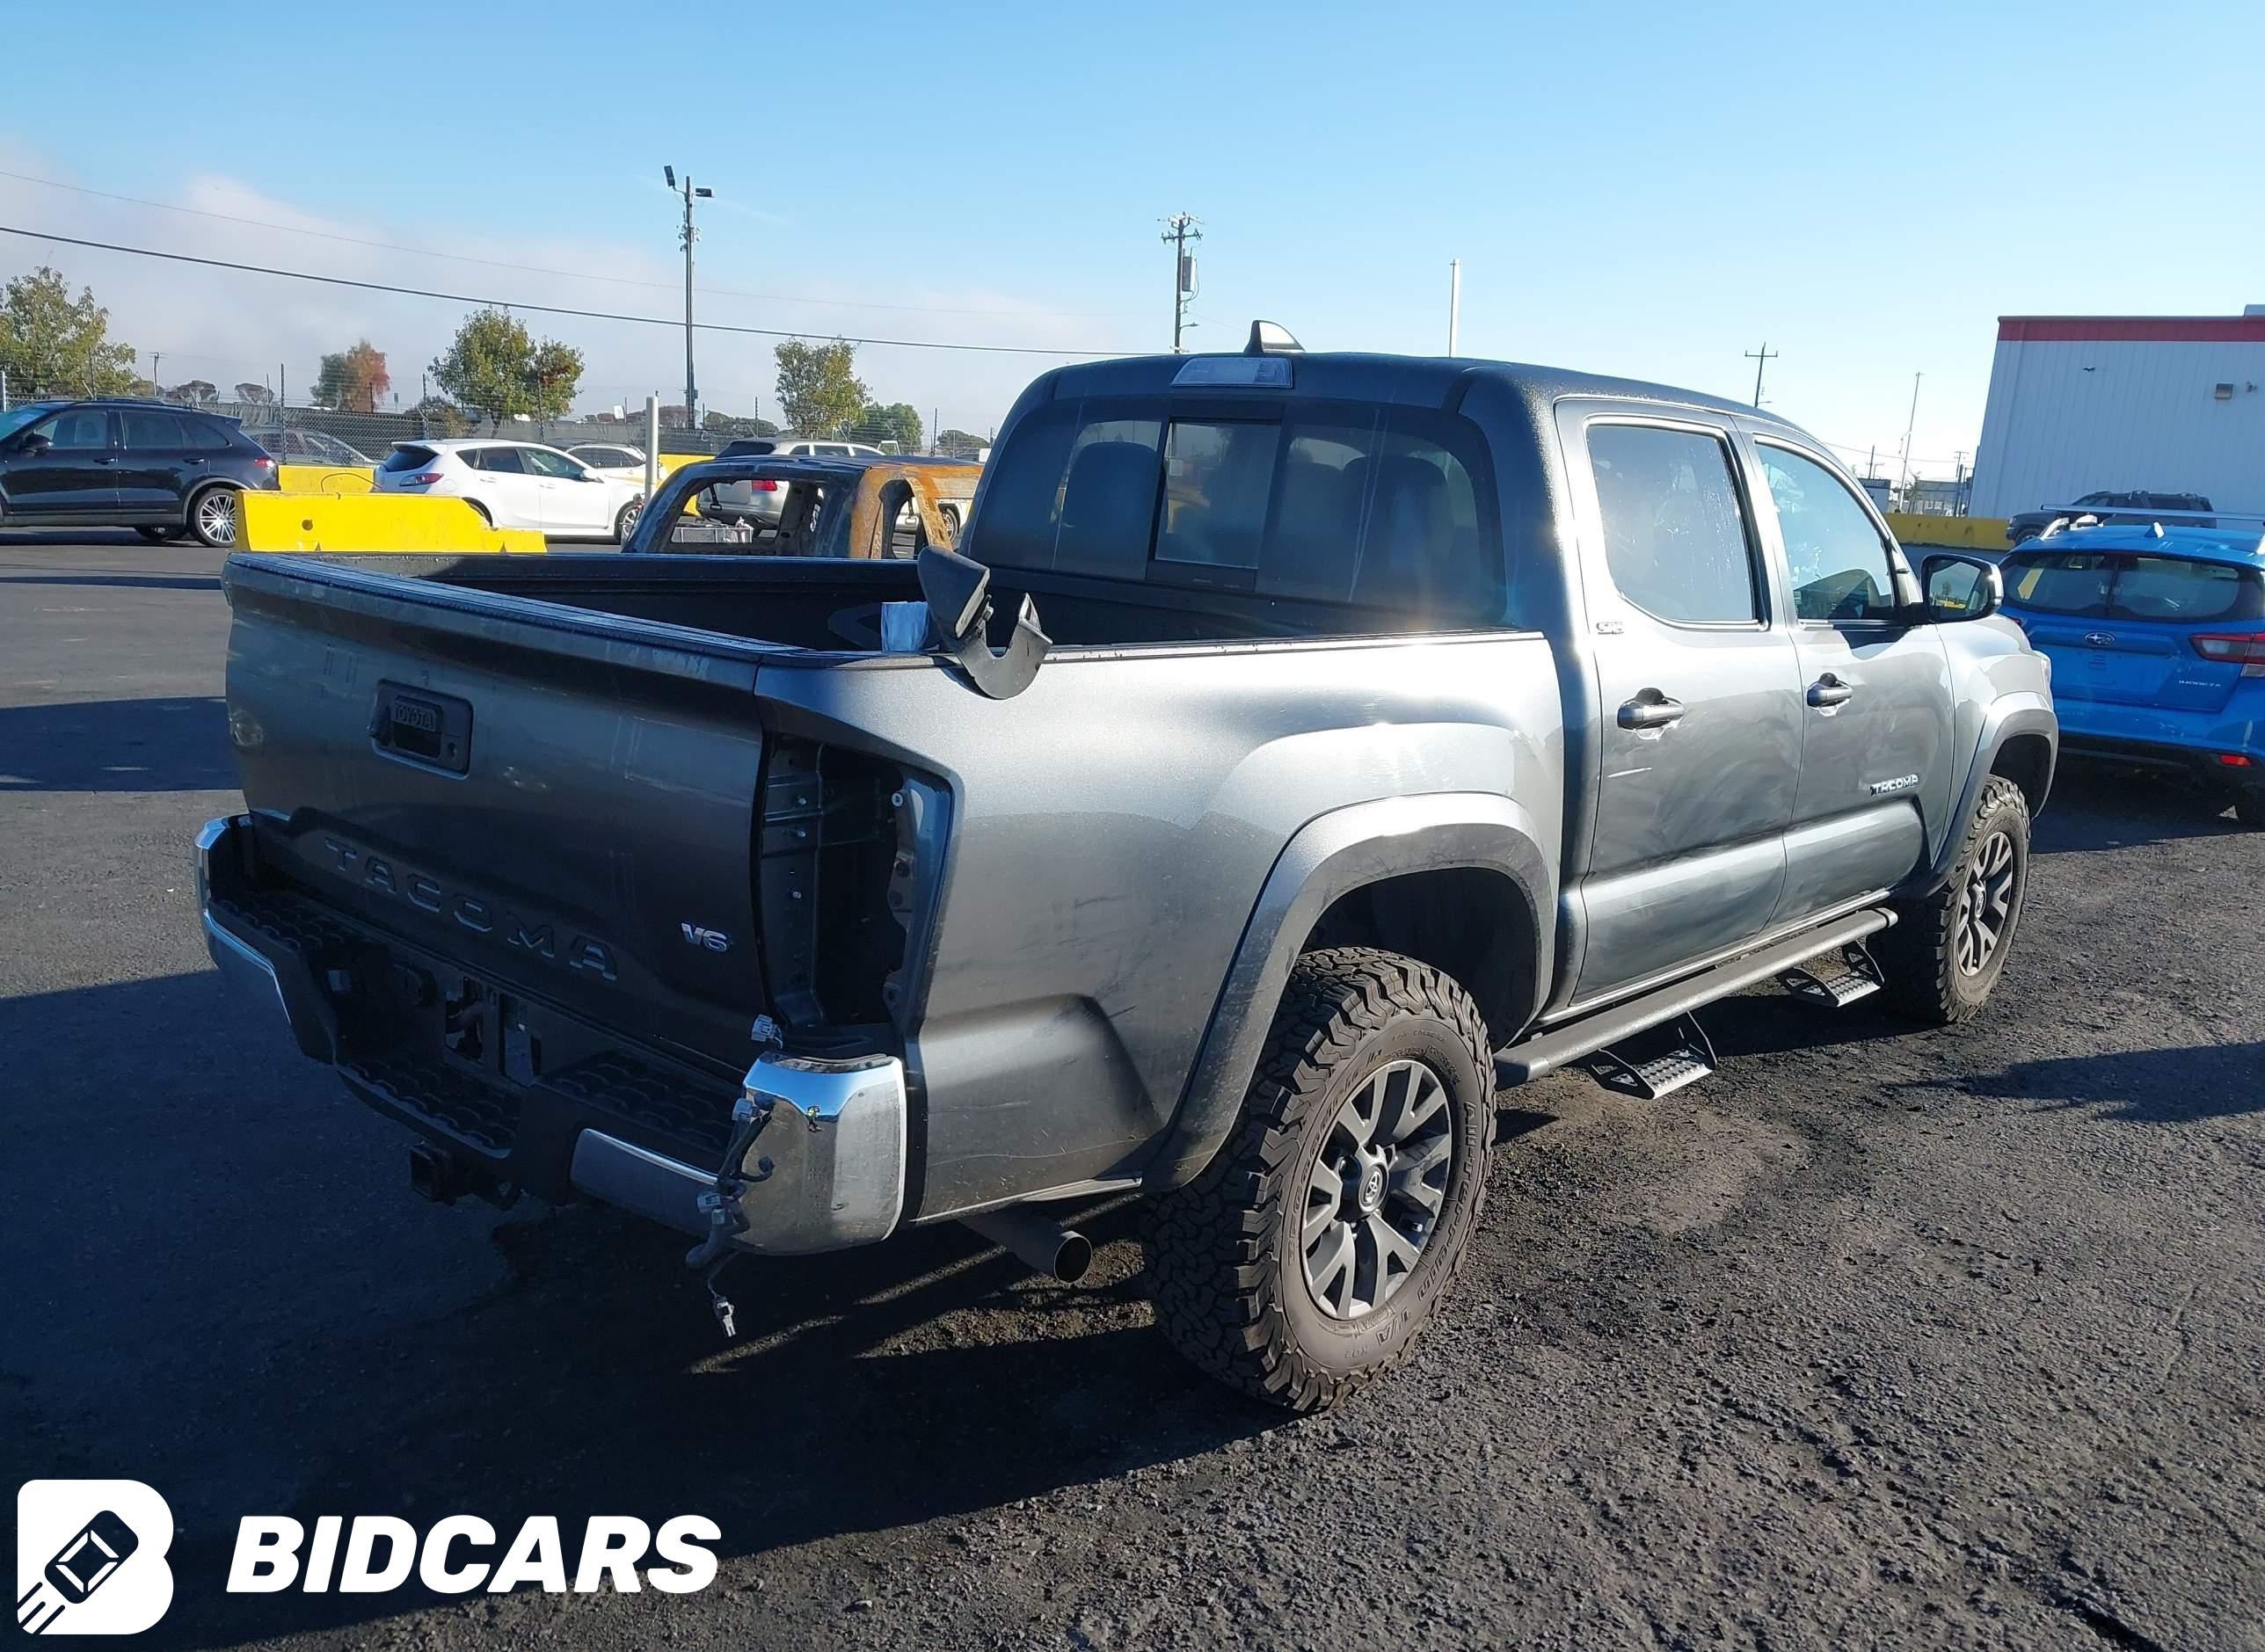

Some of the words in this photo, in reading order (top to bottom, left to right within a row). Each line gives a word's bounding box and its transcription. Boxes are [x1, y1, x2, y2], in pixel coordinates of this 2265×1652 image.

[393, 704, 436, 731] TOYOTA
[1870, 775, 1919, 796] TACOMA
[325, 836, 617, 982] TACOMA
[681, 922, 728, 952] V6
